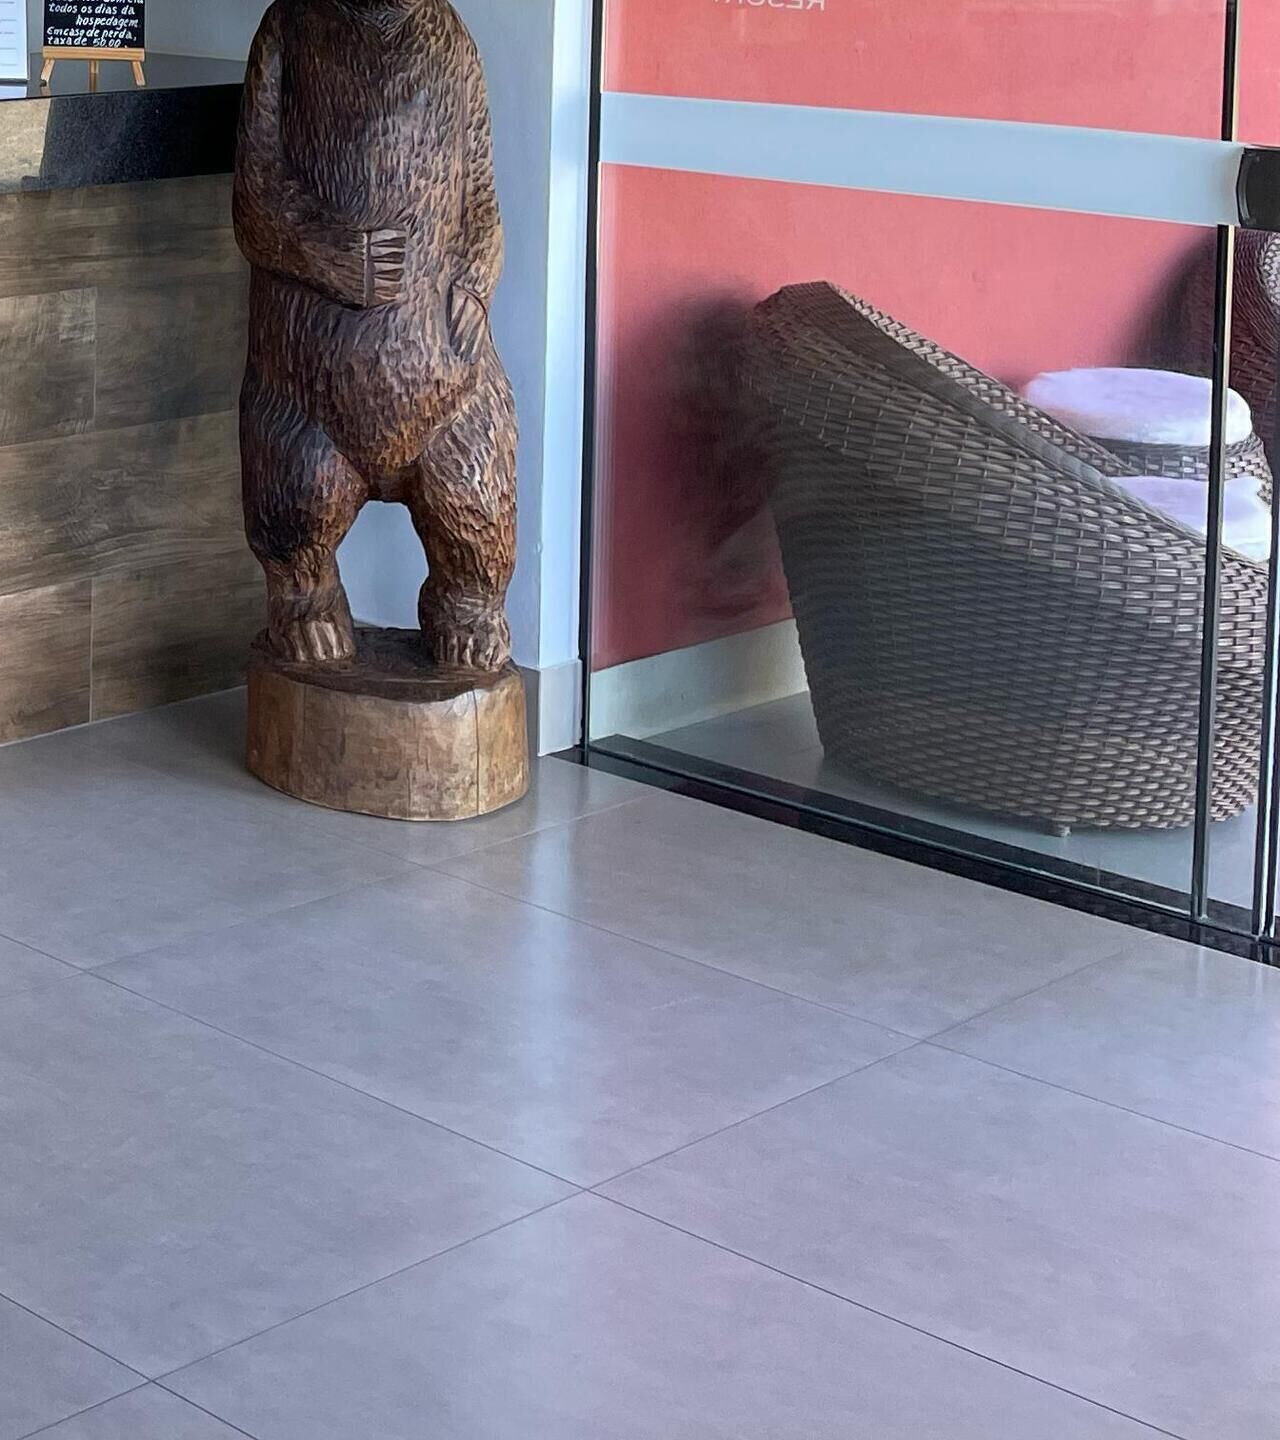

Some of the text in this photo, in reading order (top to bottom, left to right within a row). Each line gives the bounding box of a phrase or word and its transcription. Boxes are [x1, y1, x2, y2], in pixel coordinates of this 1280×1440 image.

[49, 3, 135, 15] todos os dias da
[86, 28, 100, 37] de
[48, 36, 72, 46] taxa
[74, 37, 88, 46] de
